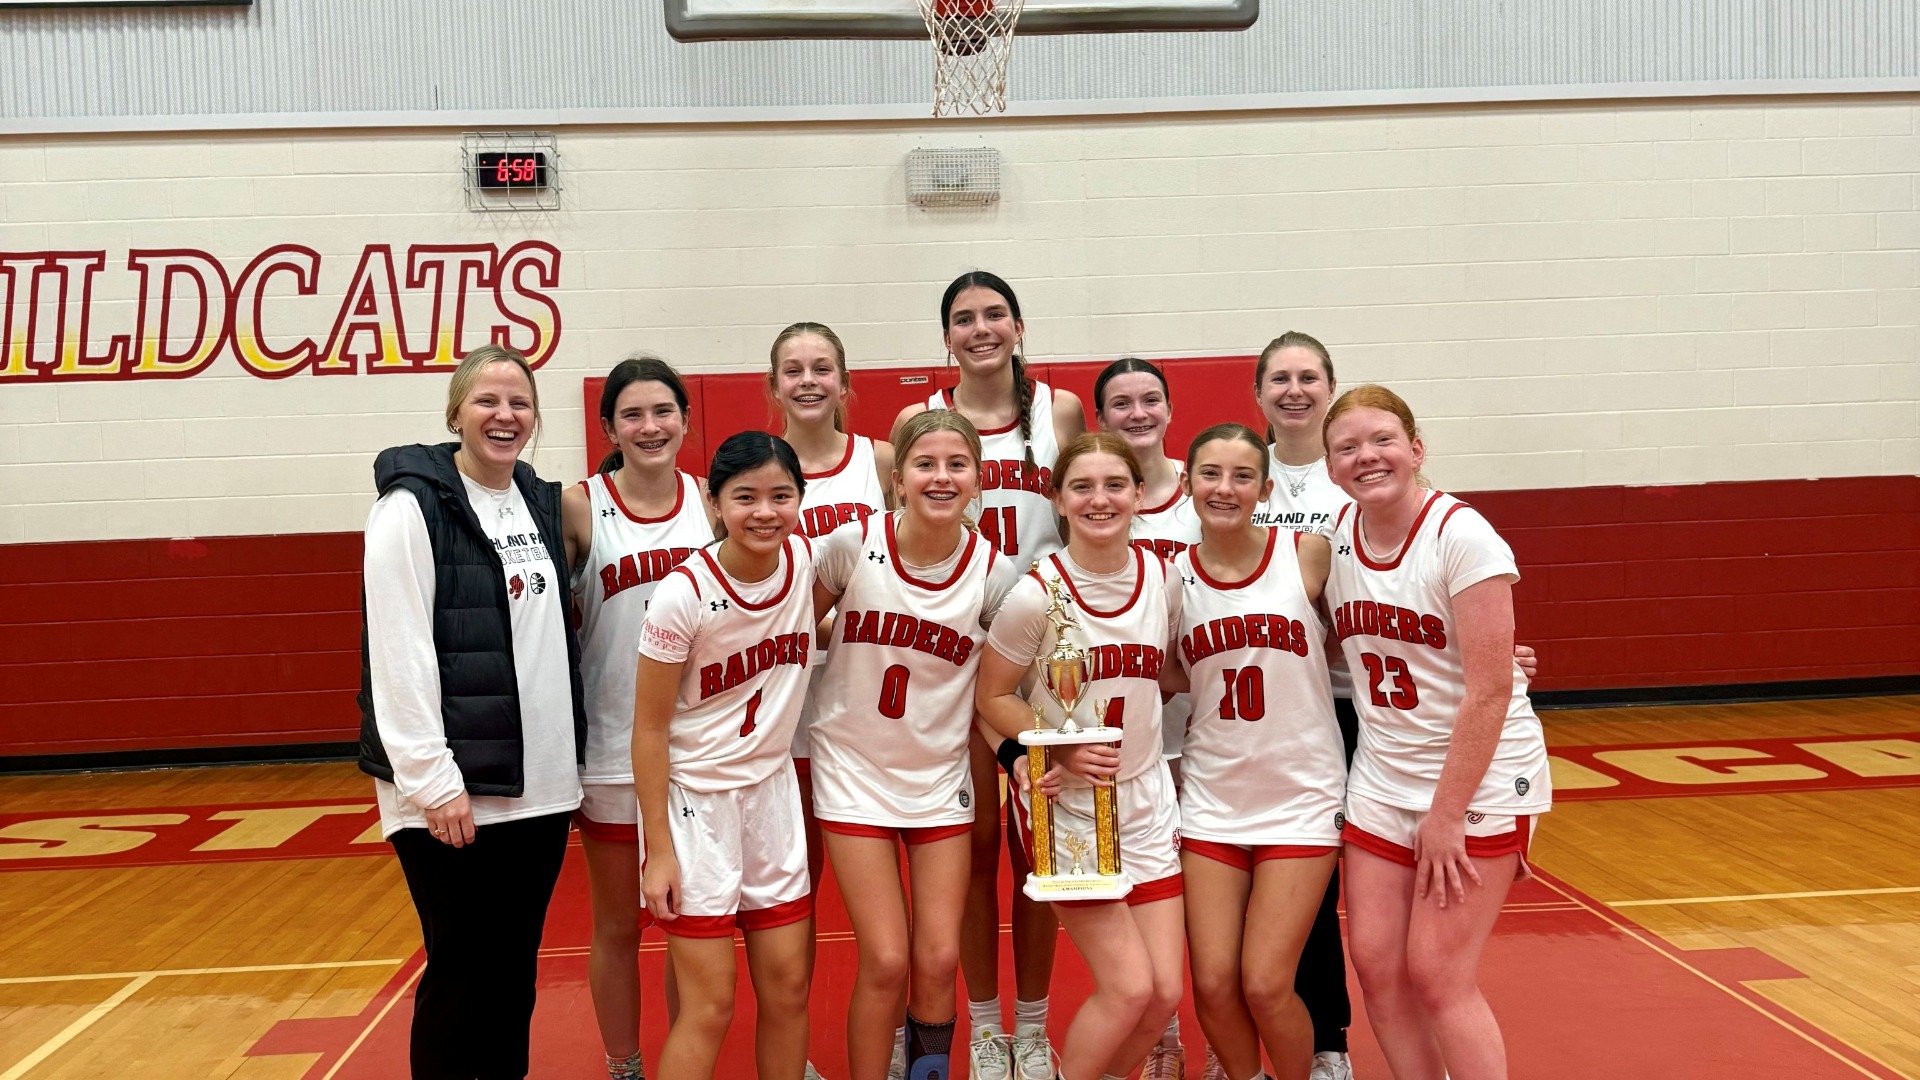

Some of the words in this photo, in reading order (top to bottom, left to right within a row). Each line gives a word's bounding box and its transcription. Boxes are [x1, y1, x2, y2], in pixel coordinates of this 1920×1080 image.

[497, 159, 535, 181] 6:58
[981, 459, 1052, 499] DERS
[978, 506, 1018, 556] 41
[1310, 513, 1330, 524] PA
[600, 547, 697, 602] RAIDE
[842, 611, 975, 666] RAIDERS
[1181, 614, 1308, 667] RAIDERS
[1335, 600, 1447, 650] RAIDERS
[1081, 644, 1165, 683] IDERS
[1361, 653, 1419, 711] 23
[740, 688, 763, 738] 1
[878, 664, 910, 720] 0
[1219, 666, 1265, 722] 10
